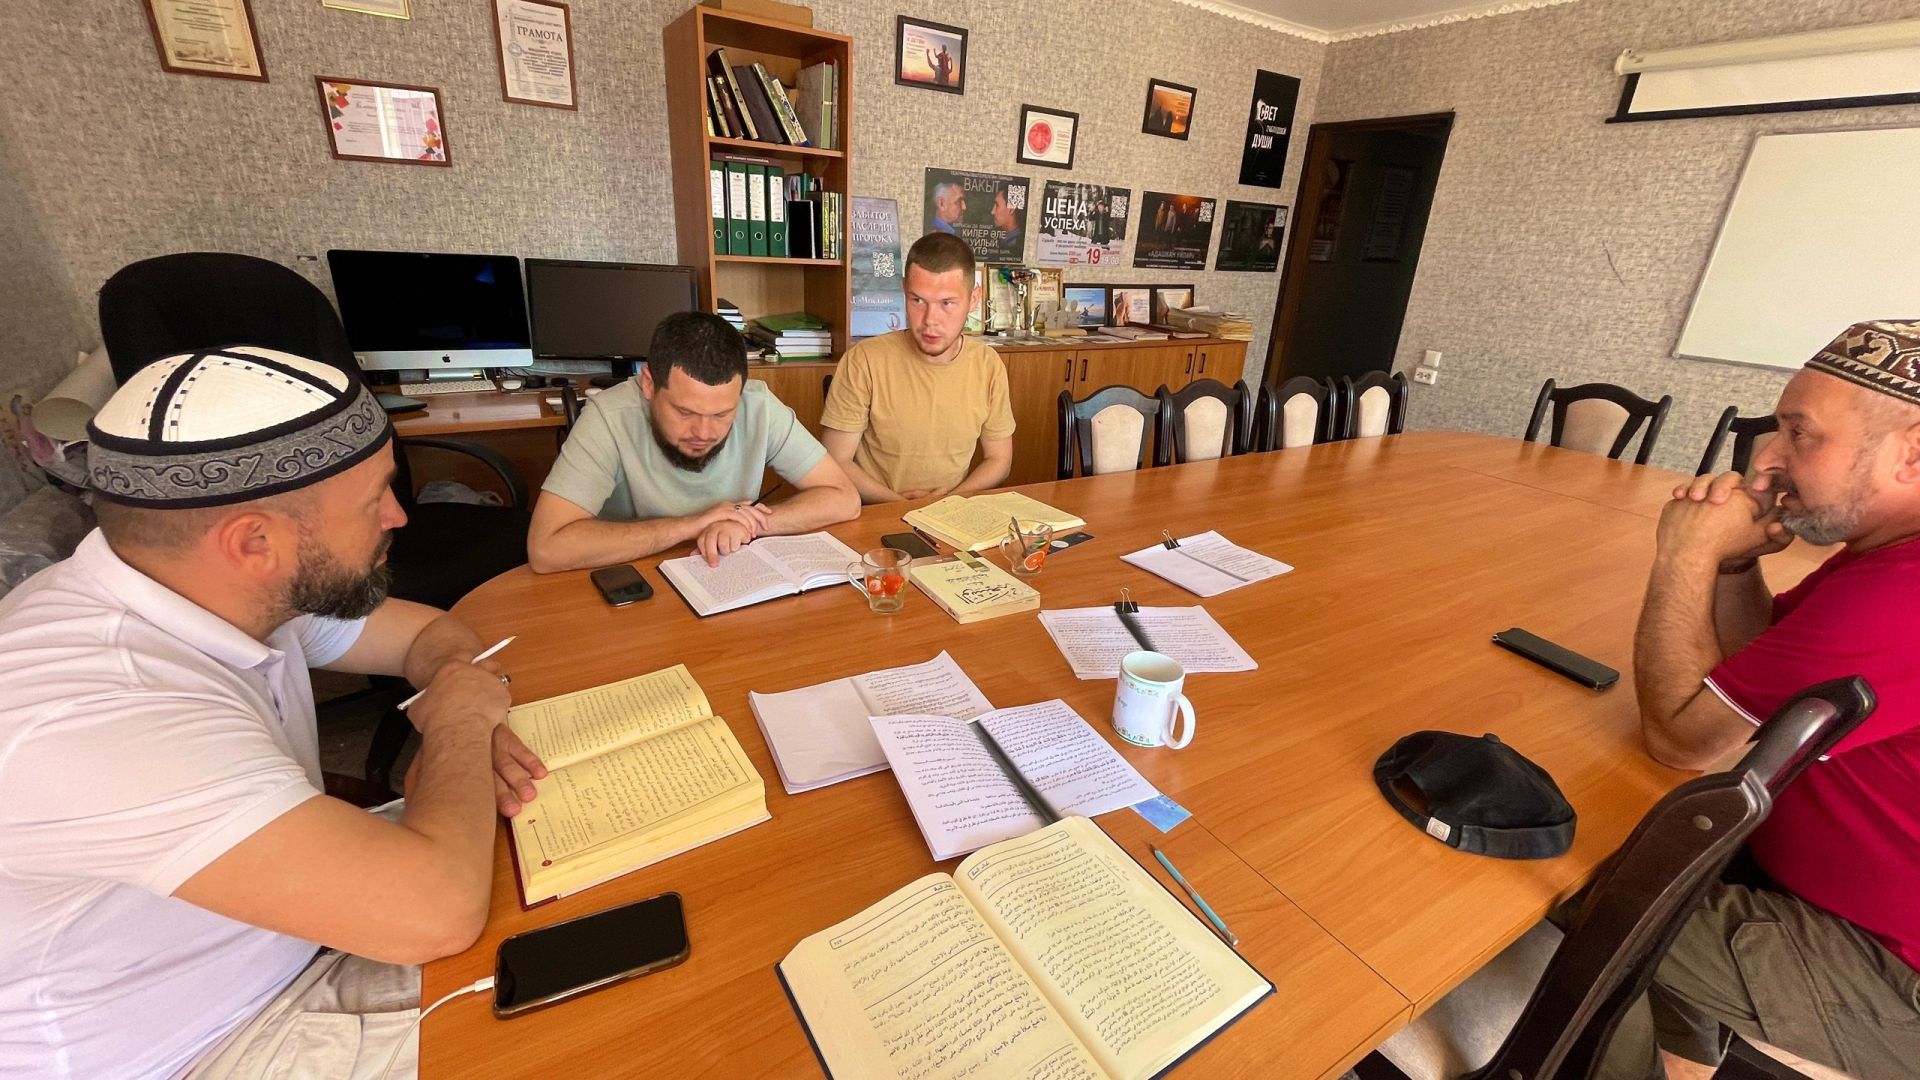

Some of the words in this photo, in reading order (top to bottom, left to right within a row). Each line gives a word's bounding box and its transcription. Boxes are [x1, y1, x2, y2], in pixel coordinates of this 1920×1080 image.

[517, 26, 563, 42] ГРАМОТА
[1260, 104, 1279, 121] СВЕТ
[1251, 133, 1274, 150] ДУШИ
[964, 177, 1000, 193] ВАКЫТ
[1046, 197, 1088, 217] ЦЕНА
[1044, 216, 1086, 231] УСПЕХА
[852, 233, 894, 243] ПРОРОКА
[962, 228, 989, 238] КИЛЕР
[990, 230, 1007, 239] ӘЛЕ
[1086, 248, 1101, 265] 19
